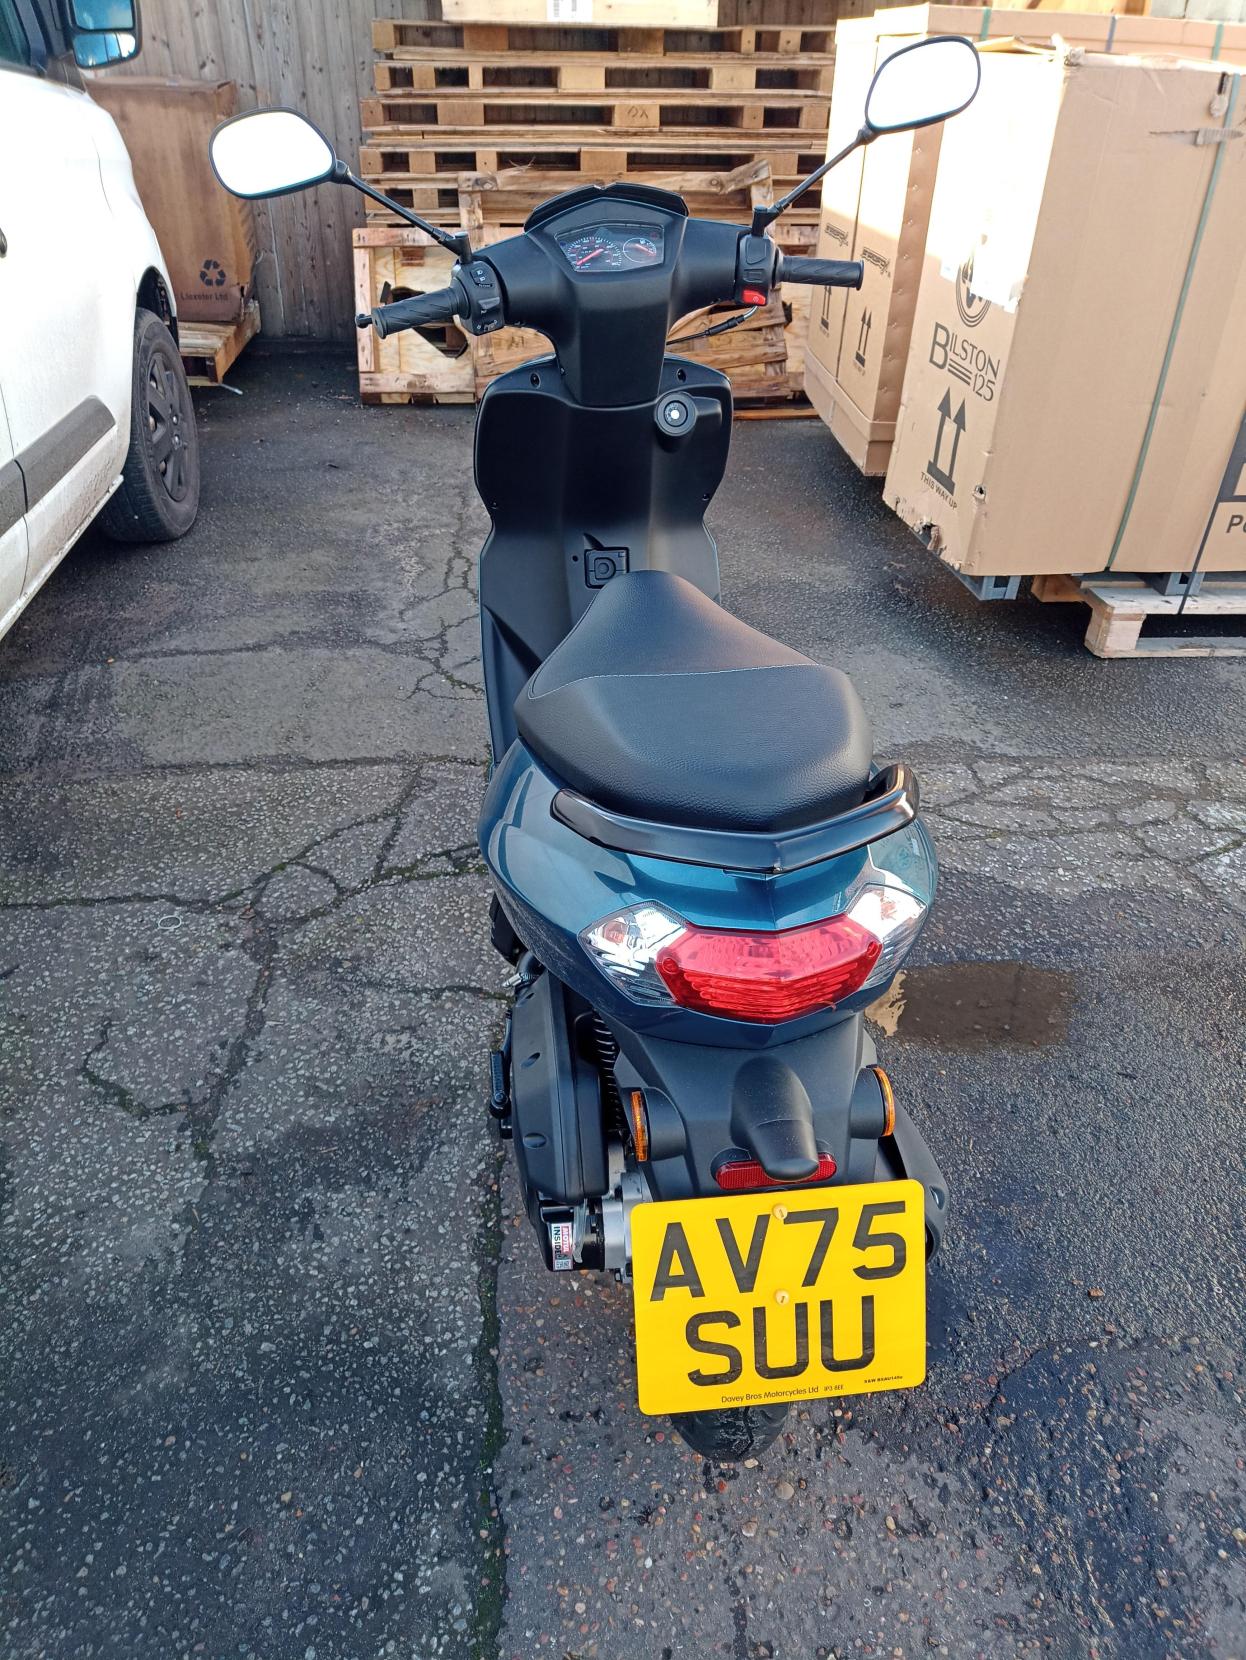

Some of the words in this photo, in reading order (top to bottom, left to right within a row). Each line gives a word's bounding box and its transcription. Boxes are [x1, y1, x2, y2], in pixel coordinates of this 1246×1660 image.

[929, 321, 1001, 380] BILSTON
[972, 373, 996, 402] 125
[921, 471, 935, 490] THIS
[935, 485, 949, 502] WAY
[948, 497, 958, 511] UP
[649, 1200, 907, 1301] AV75
[685, 1295, 875, 1387] SUU
[721, 1395, 744, 1403] Davey
[745, 1392, 762, 1401] Bros
[763, 1387, 807, 1399] Motorcycles
[808, 1385, 819, 1394] Ltd
